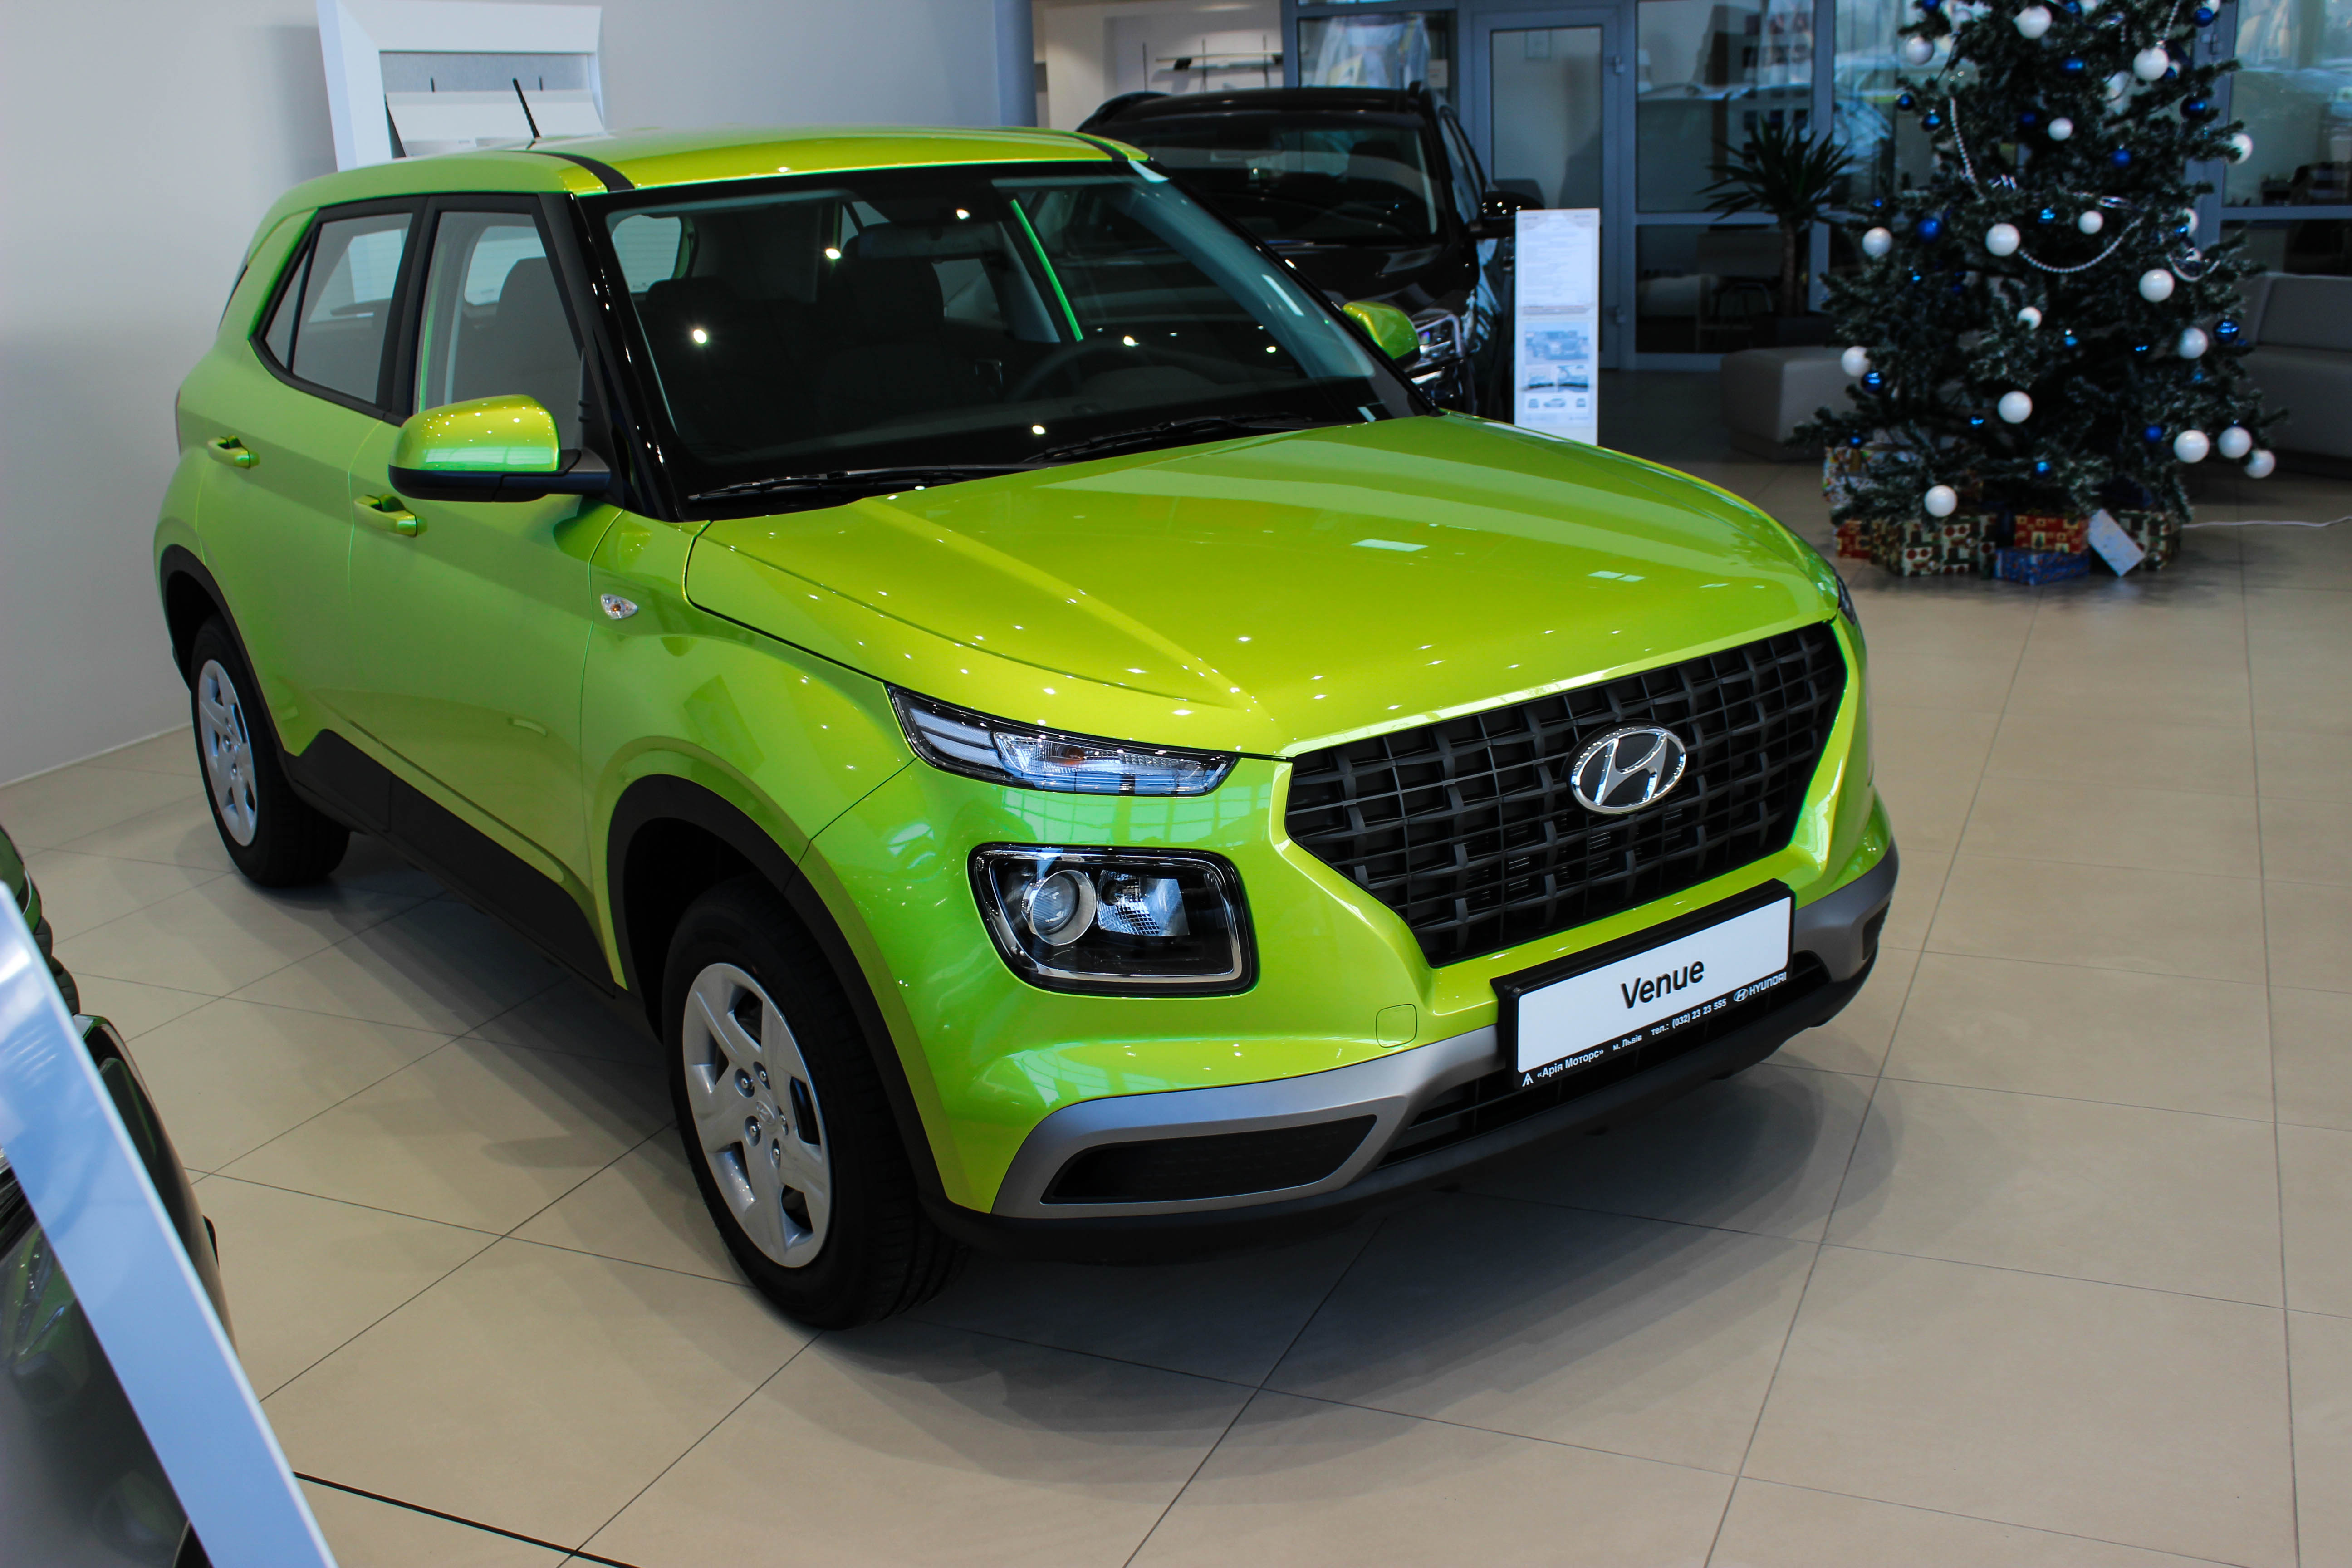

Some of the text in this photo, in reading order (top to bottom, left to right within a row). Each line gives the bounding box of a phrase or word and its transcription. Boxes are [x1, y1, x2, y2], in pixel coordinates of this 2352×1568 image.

[1621, 961, 1704, 1009] Venue
[1749, 972, 1787, 996] HYUNDAI
[1622, 1035, 1642, 1047] Львів
[1672, 1013, 1690, 1029] (032)
[1692, 1009, 1701, 1019] 23
[1703, 1004, 1712, 1015] 23
[1714, 999, 1727, 1010] 555
